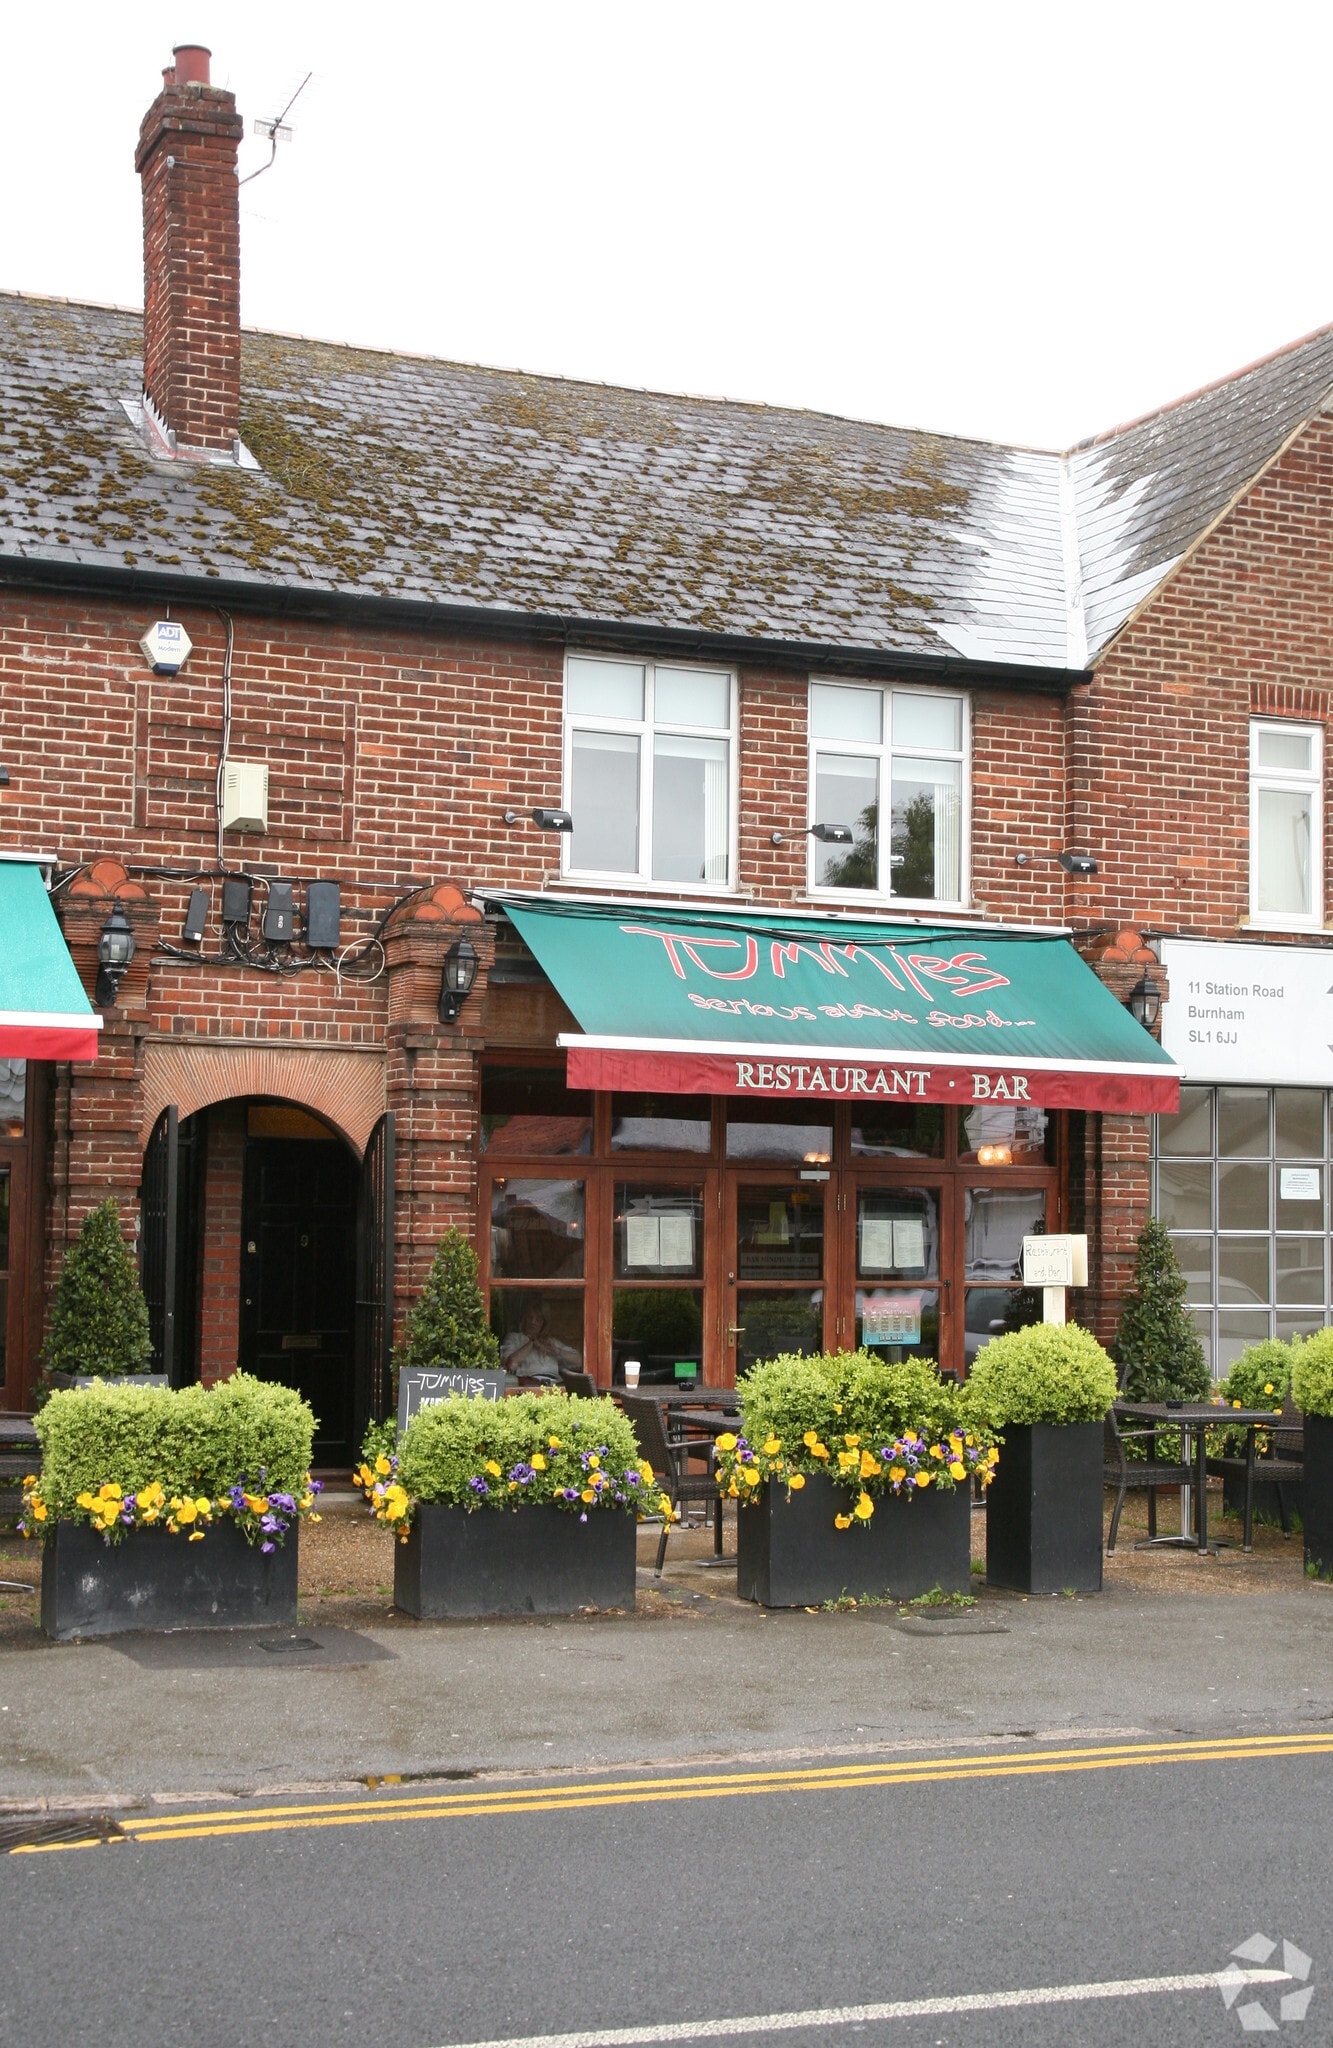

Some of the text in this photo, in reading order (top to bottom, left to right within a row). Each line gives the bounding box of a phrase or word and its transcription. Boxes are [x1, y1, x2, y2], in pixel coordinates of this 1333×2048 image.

[158, 626, 181, 639] ADT
[1188, 981, 1284, 998] 11 Station Road
[687, 993, 817, 1021] serious
[818, 1002, 918, 1025] about
[1188, 1005, 1245, 1020] Burnham
[1188, 1030, 1237, 1044] SL1 6JJ
[735, 1062, 1031, 1100] RESTAURANT BAR
